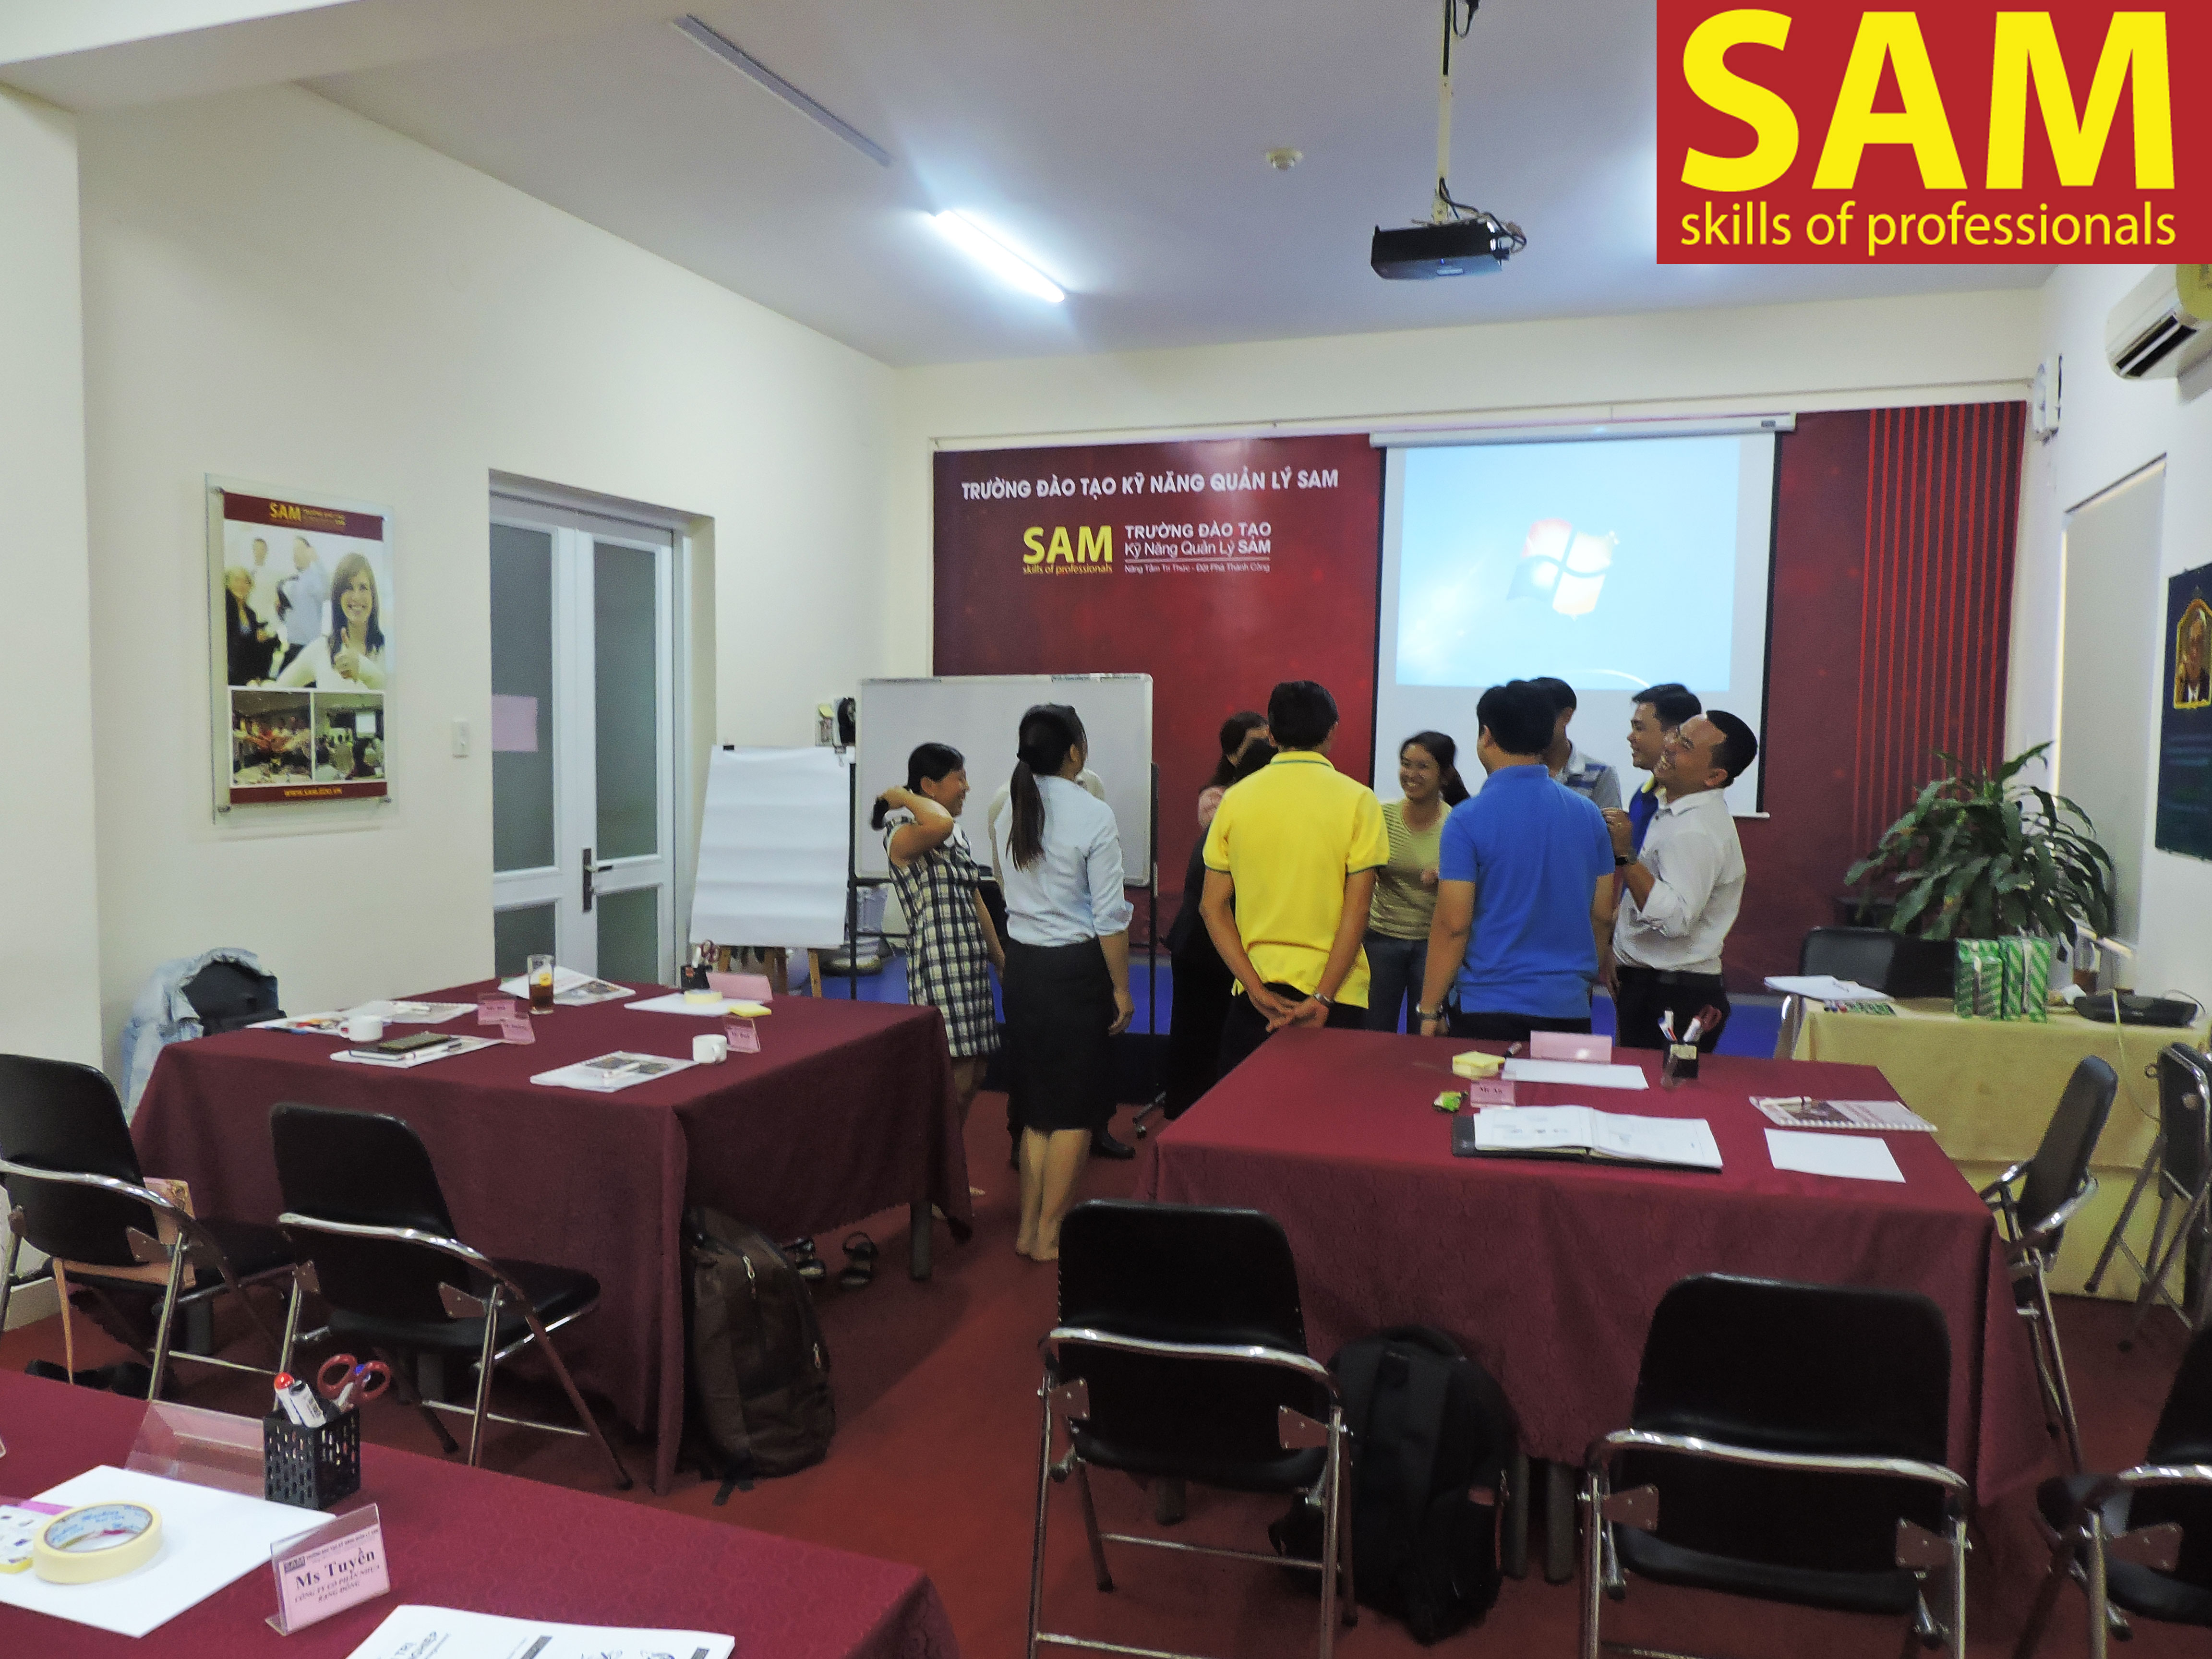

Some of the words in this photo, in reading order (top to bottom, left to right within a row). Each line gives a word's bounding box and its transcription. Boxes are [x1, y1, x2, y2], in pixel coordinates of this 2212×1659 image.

[962, 476, 1032, 500] TRƯỜNG
[1036, 474, 1076, 497] ĐÀO
[1080, 476, 1117, 501] TẠO
[1297, 469, 1338, 490] SAM
[270, 501, 301, 522] SAM
[1125, 521, 1194, 539] TRƯỜNG
[1198, 520, 1233, 538] ĐÀO
[1238, 521, 1272, 540] TẠO
[1023, 525, 1113, 564] SAM
[1238, 539, 1271, 554] SAM
[296, 1572, 320, 1590] Ms
